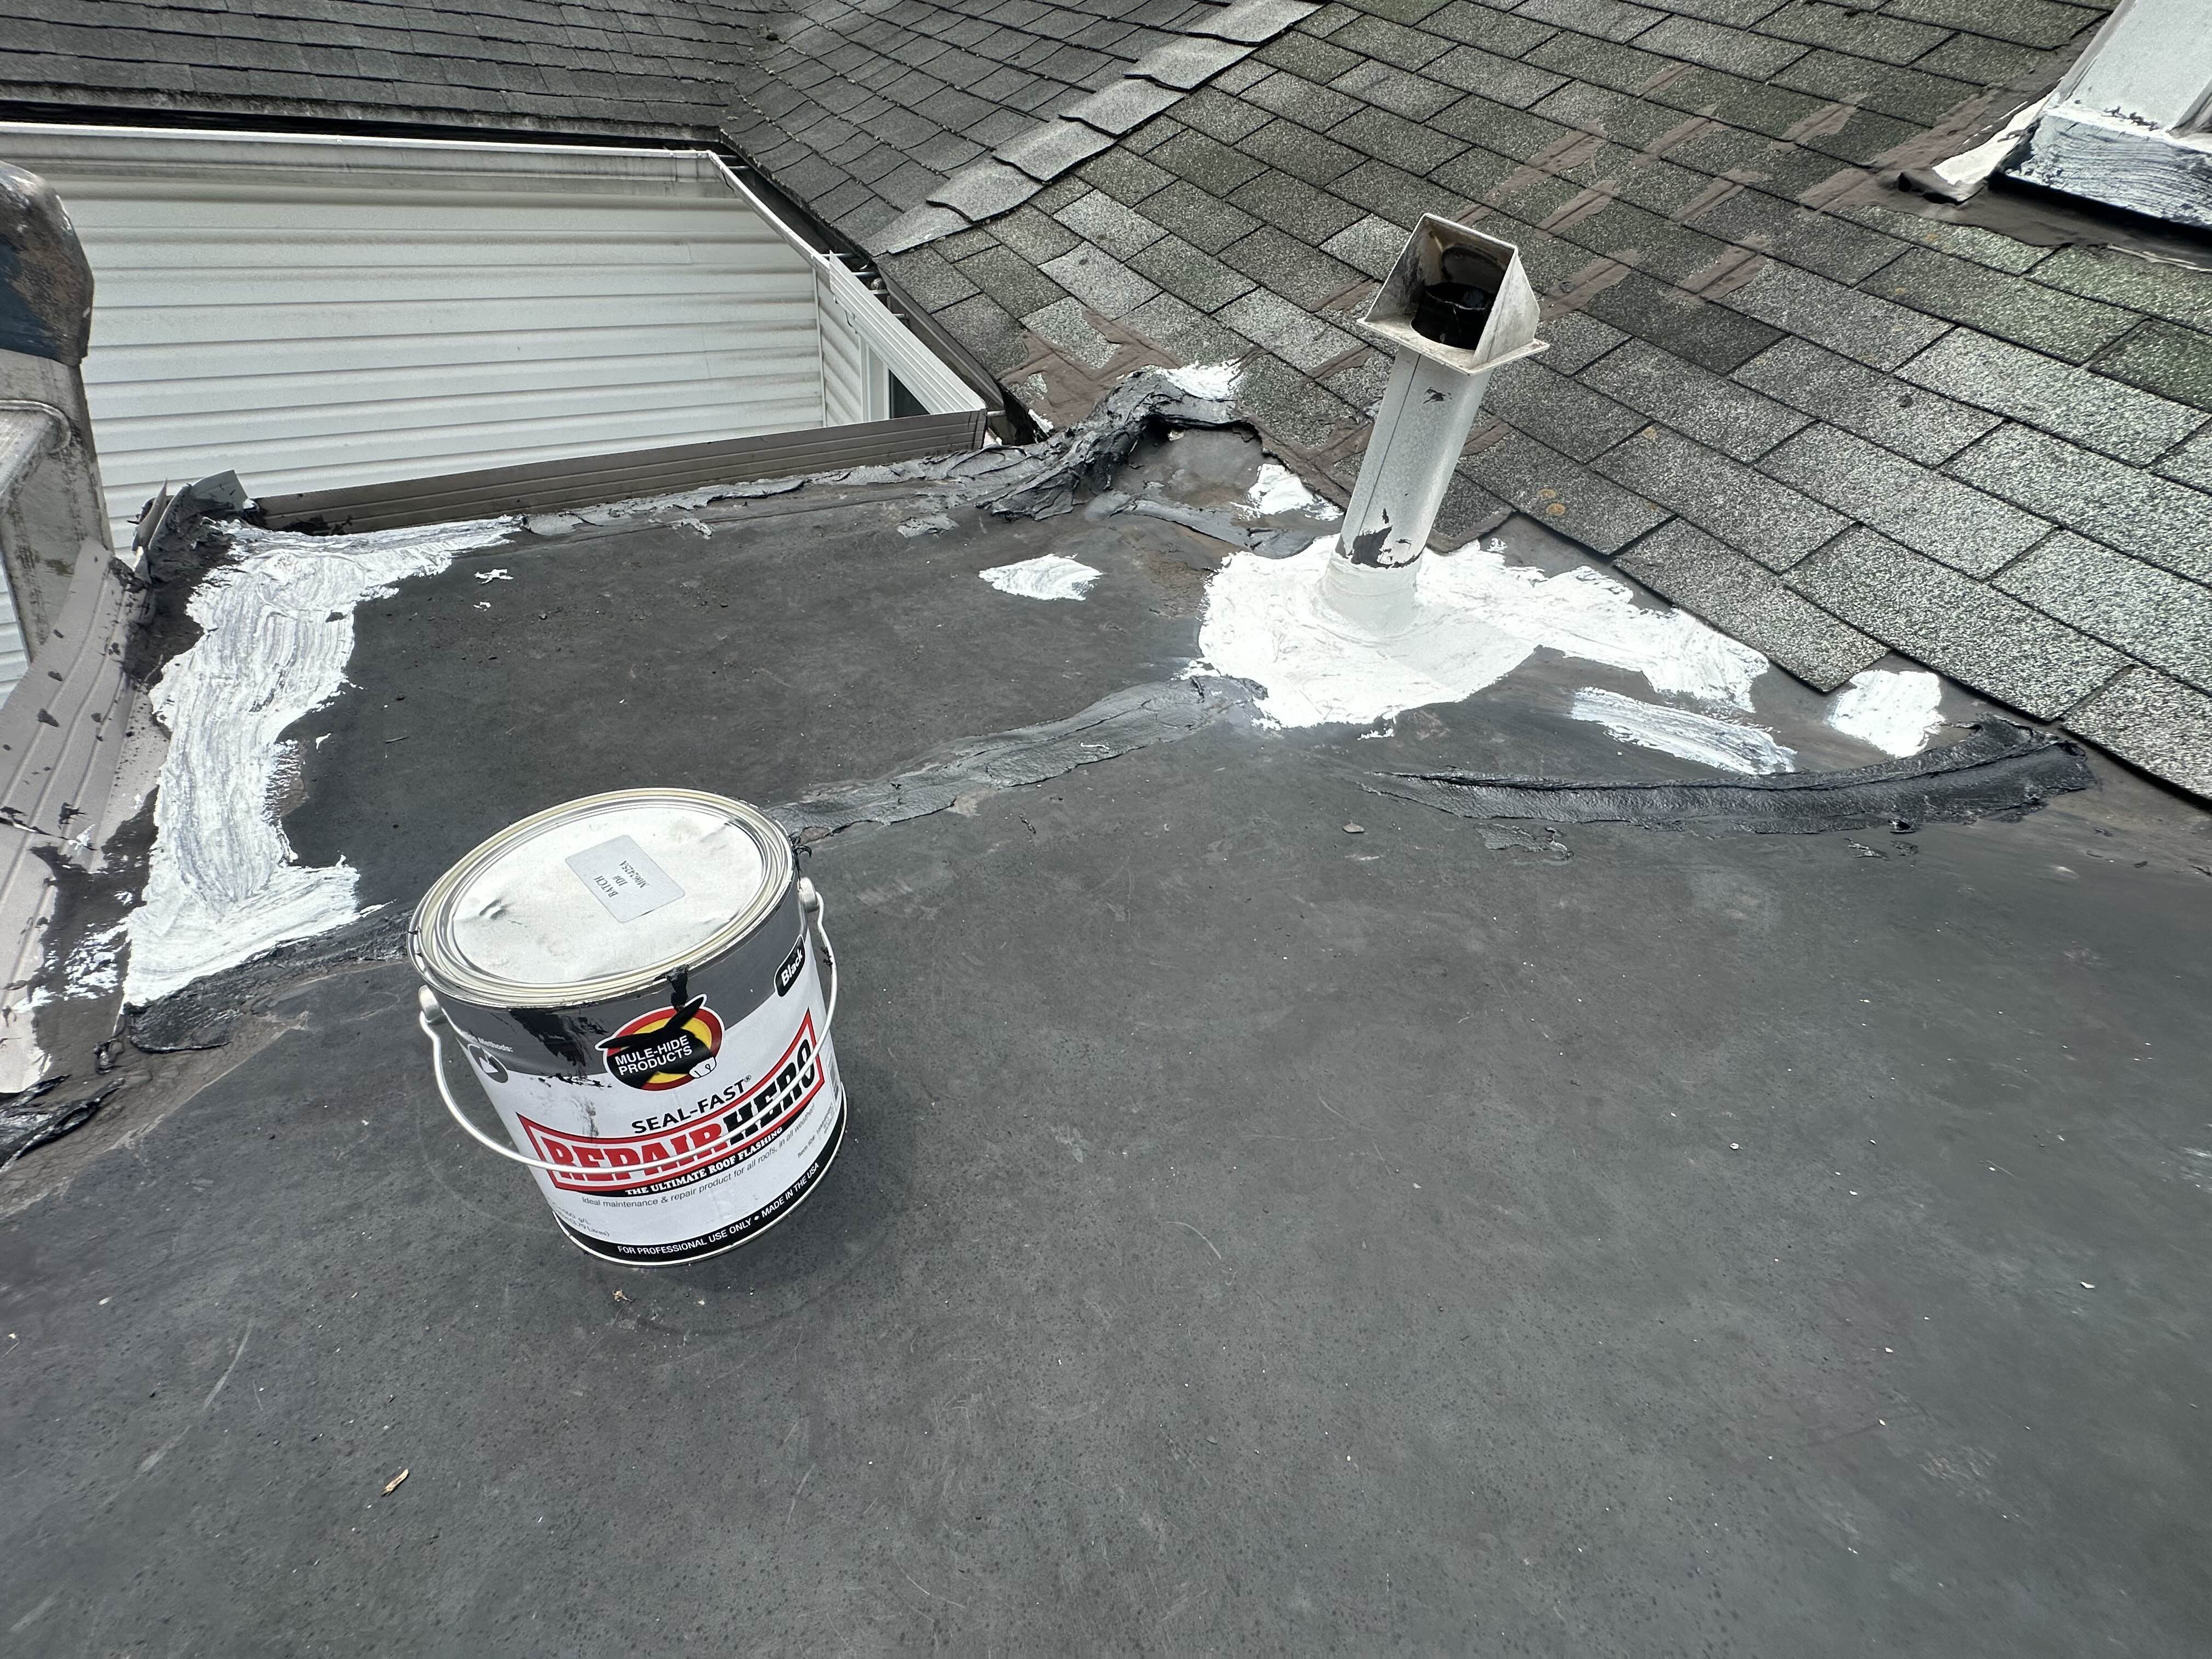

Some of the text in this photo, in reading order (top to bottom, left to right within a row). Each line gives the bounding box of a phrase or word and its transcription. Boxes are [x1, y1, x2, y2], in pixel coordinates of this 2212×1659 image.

[594, 876, 619, 898] BATCH
[781, 949, 803, 986] Black
[614, 1035, 690, 1066] MULE-HIDE
[618, 1045, 693, 1076] PRODUCTS
[582, 1197, 600, 1206] Ideal
[603, 1199, 658, 1207] maintenance
[670, 1188, 696, 1201] repair
[698, 1173, 732, 1194] product
[733, 1165, 746, 1178] for
[747, 1160, 756, 1171] all
[778, 1138, 786, 1149] in
[786, 1130, 794, 1141] all
[625, 1126, 783, 1196] THE ULTIMATE ROOF FLASHING
[617, 1162, 820, 1255] FOR PROFESSIONAL USE ONLY MADE IN THE USA
